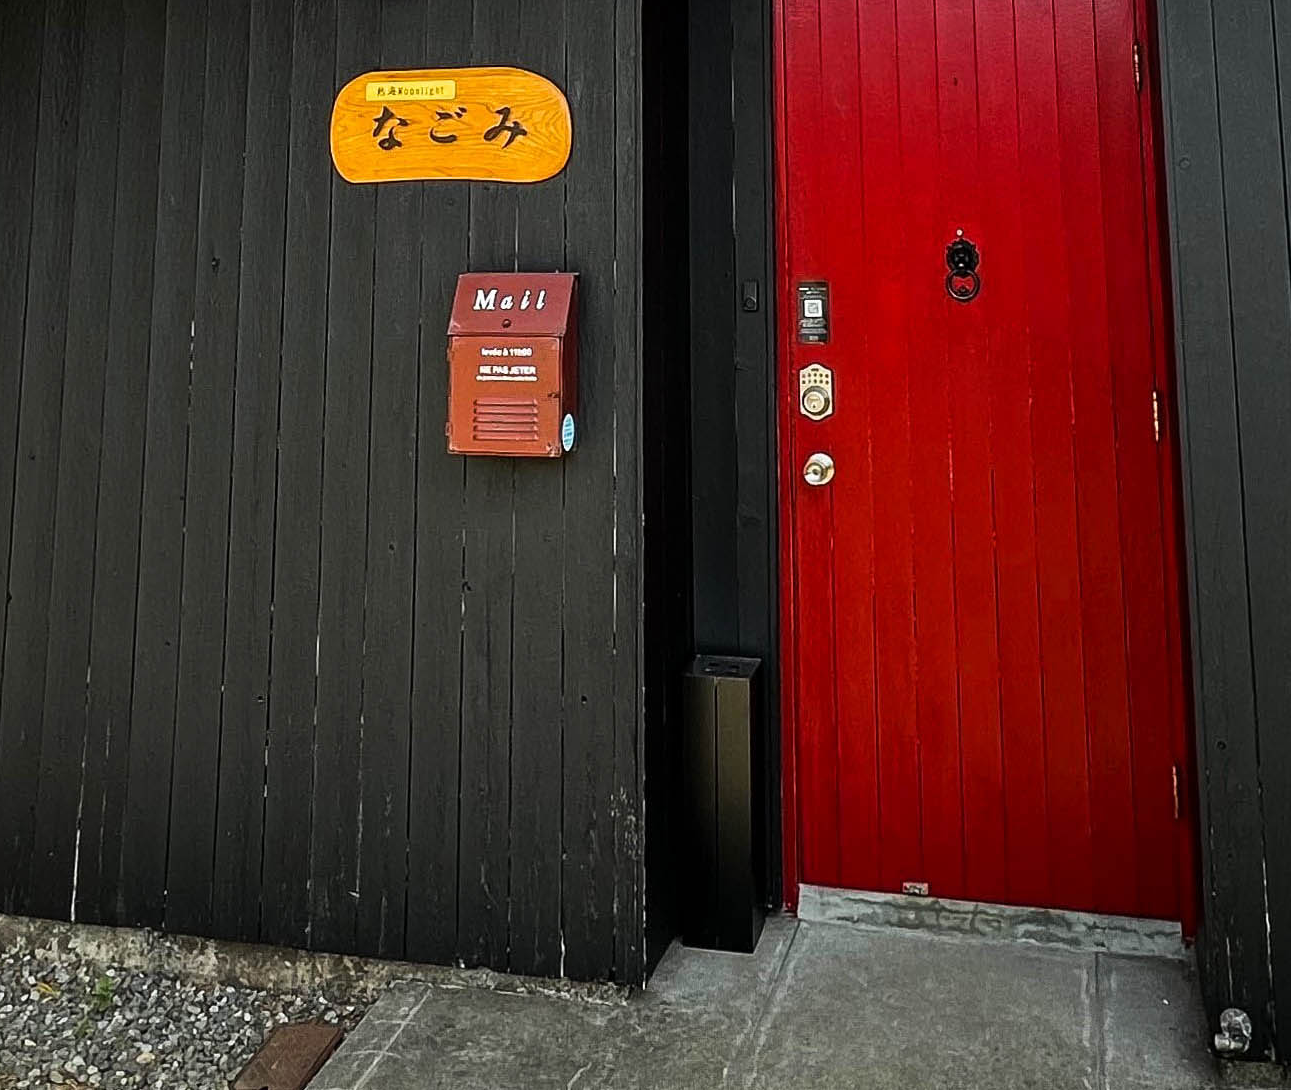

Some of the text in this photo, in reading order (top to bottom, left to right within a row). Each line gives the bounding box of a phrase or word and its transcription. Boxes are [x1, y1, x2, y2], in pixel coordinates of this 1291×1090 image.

[372, 106, 528, 150] なごみ
[472, 289, 547, 311] Mail
[492, 365, 509, 375] PAS
[509, 366, 536, 375] JETER
